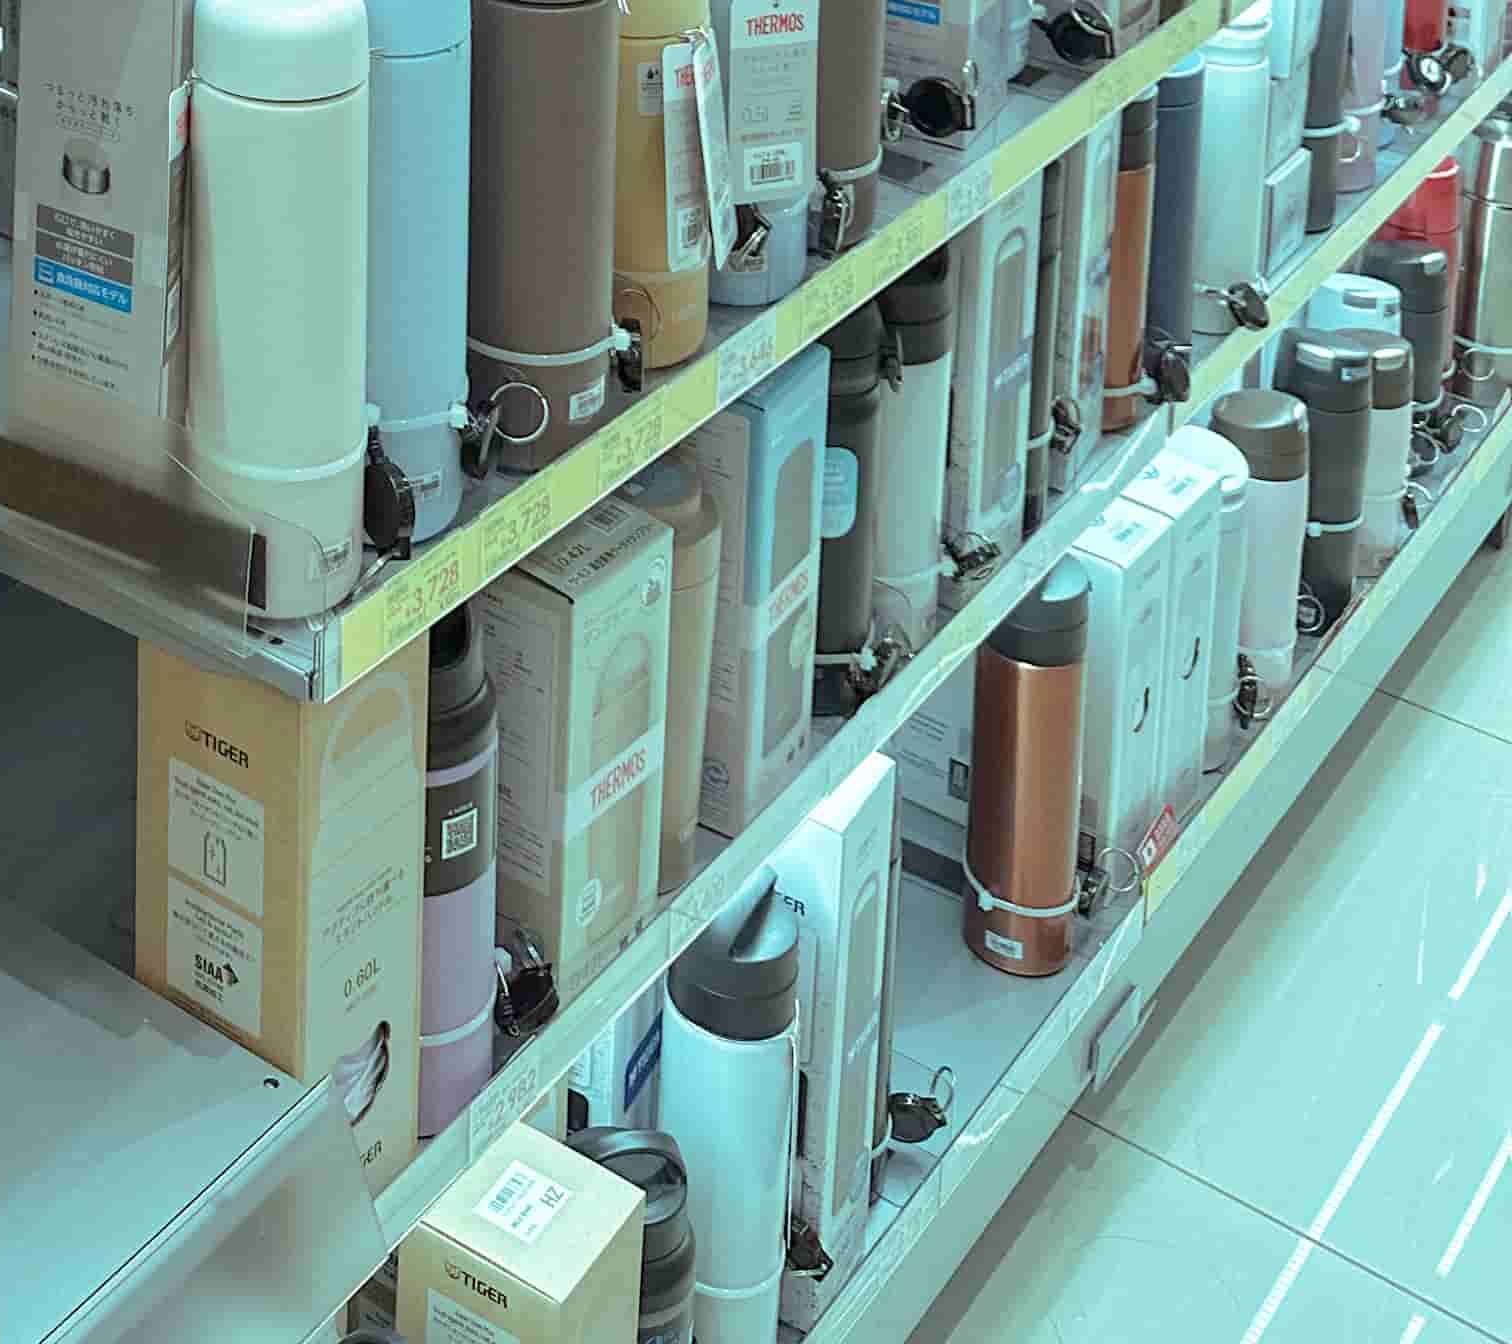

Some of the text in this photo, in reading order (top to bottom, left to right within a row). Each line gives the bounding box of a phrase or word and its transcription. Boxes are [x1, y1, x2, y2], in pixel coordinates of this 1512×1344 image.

[746, 12, 806, 37] THERMOS
[201, 729, 250, 770] TIGER
[590, 747, 647, 810] THERMOS
[194, 954, 224, 985] SIAA
[461, 1269, 508, 1311] TIGER
